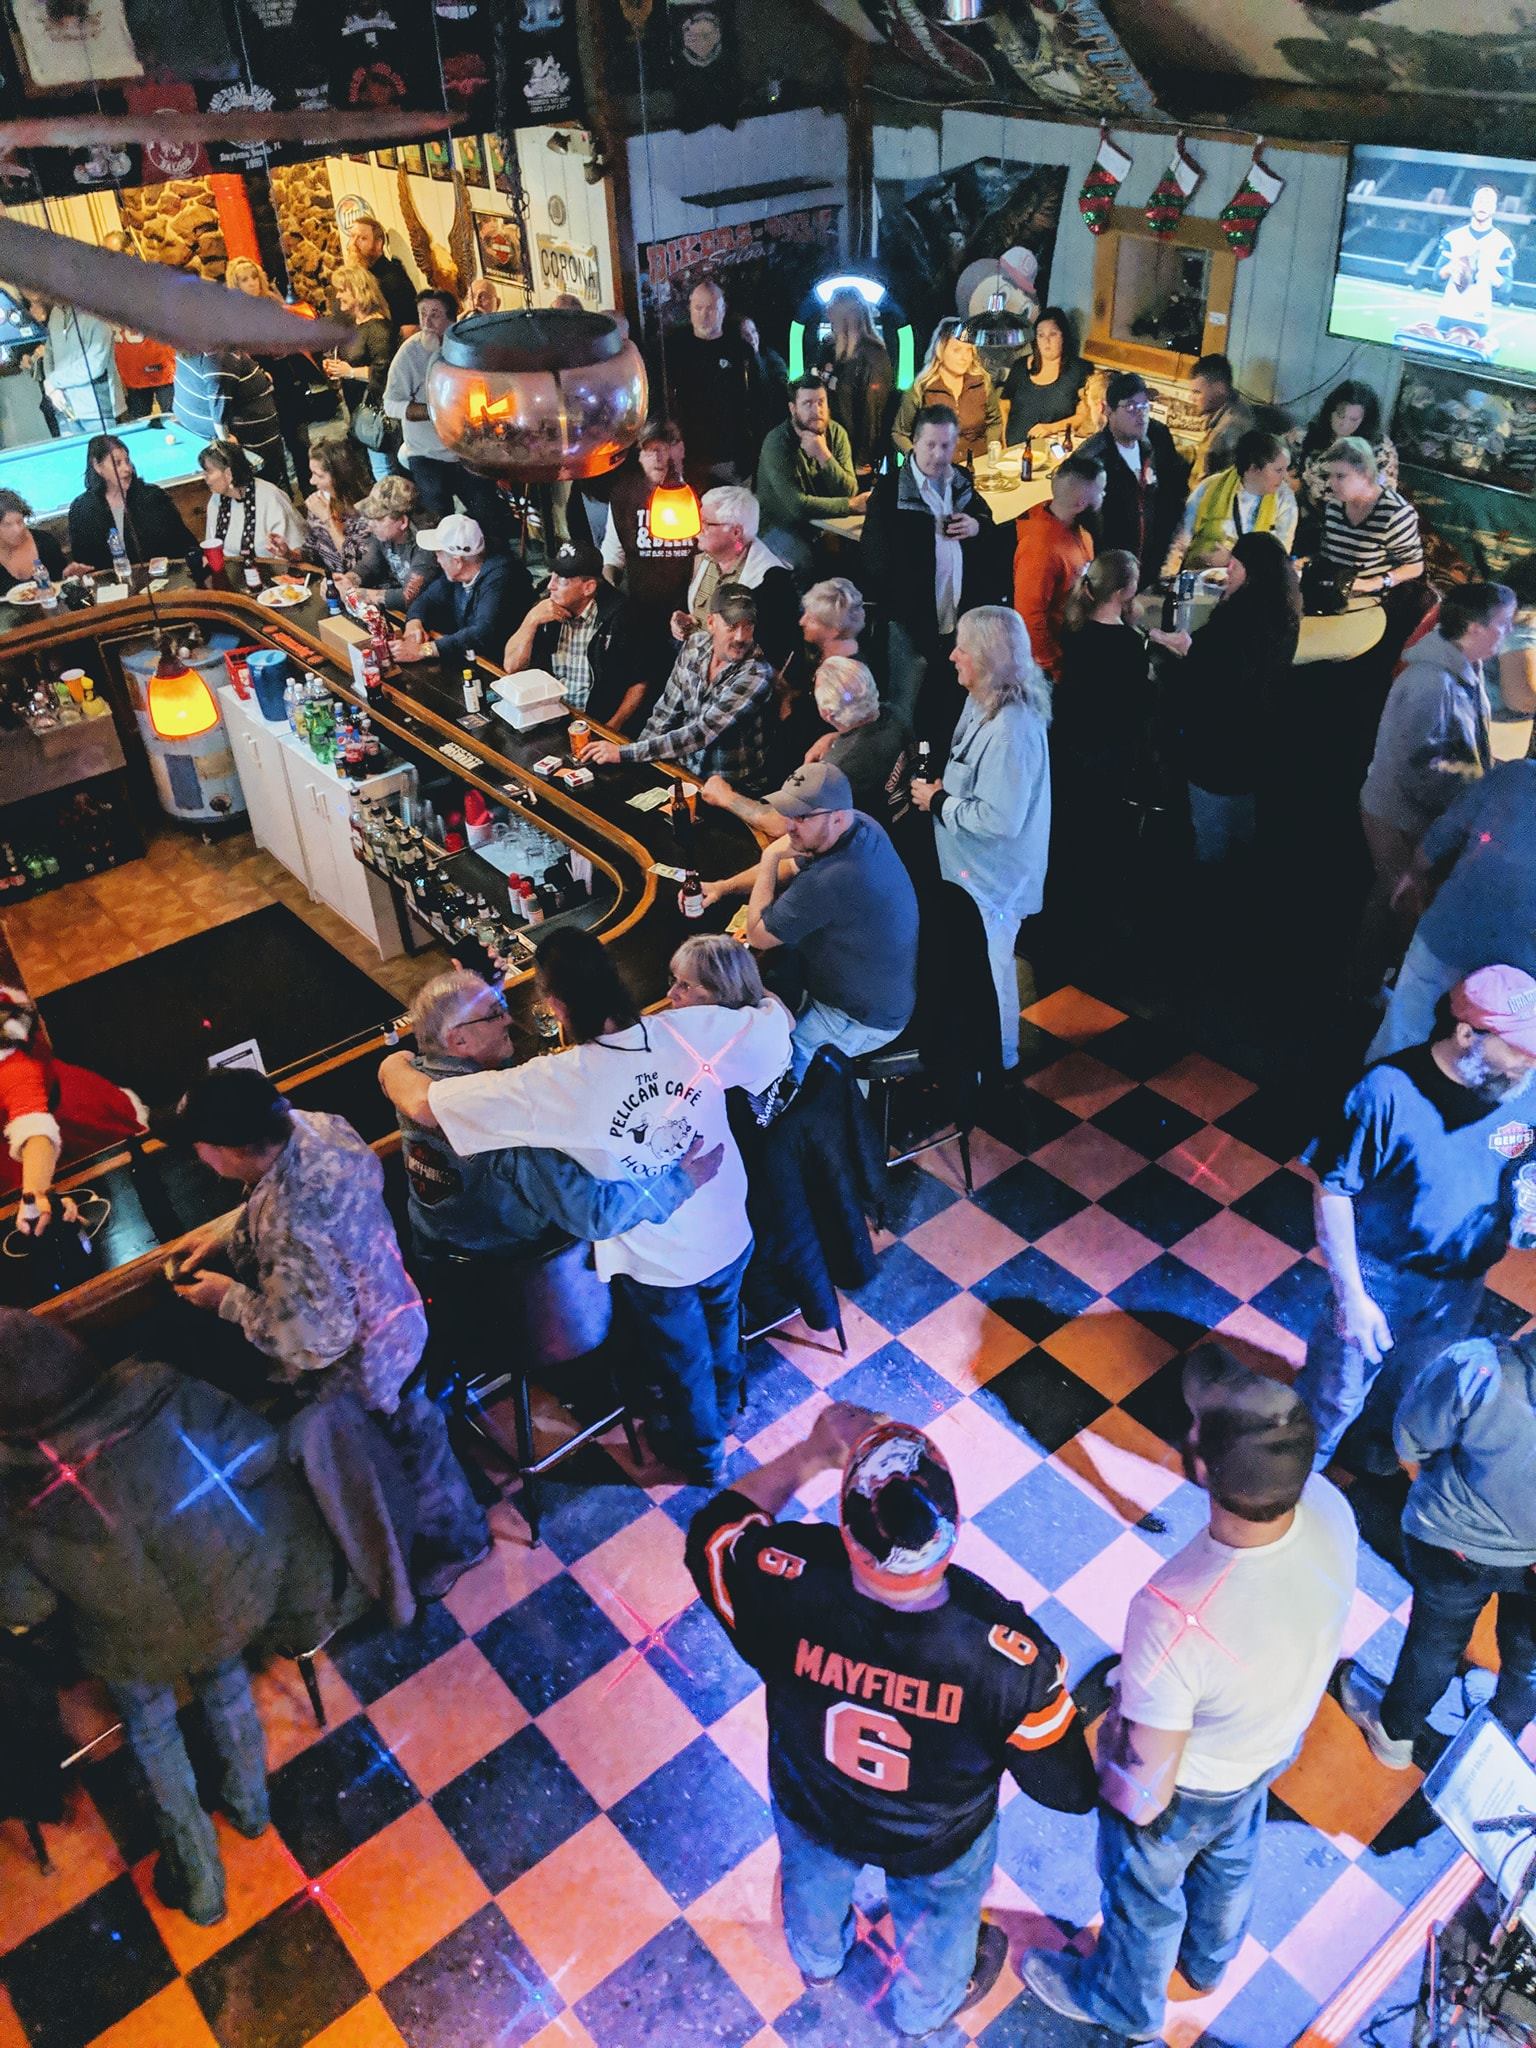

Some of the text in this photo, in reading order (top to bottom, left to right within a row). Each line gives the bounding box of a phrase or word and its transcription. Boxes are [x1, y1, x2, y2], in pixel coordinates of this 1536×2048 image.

[541, 248, 598, 287] CORONA
[637, 527, 652, 548] &
[635, 1072, 658, 1085] The
[609, 1082, 660, 1138] PELICAN
[757, 1547, 806, 1580] 6
[988, 1624, 1039, 1666] 6
[794, 1638, 963, 1724] MAYFIELD
[825, 1700, 912, 1792] 6
